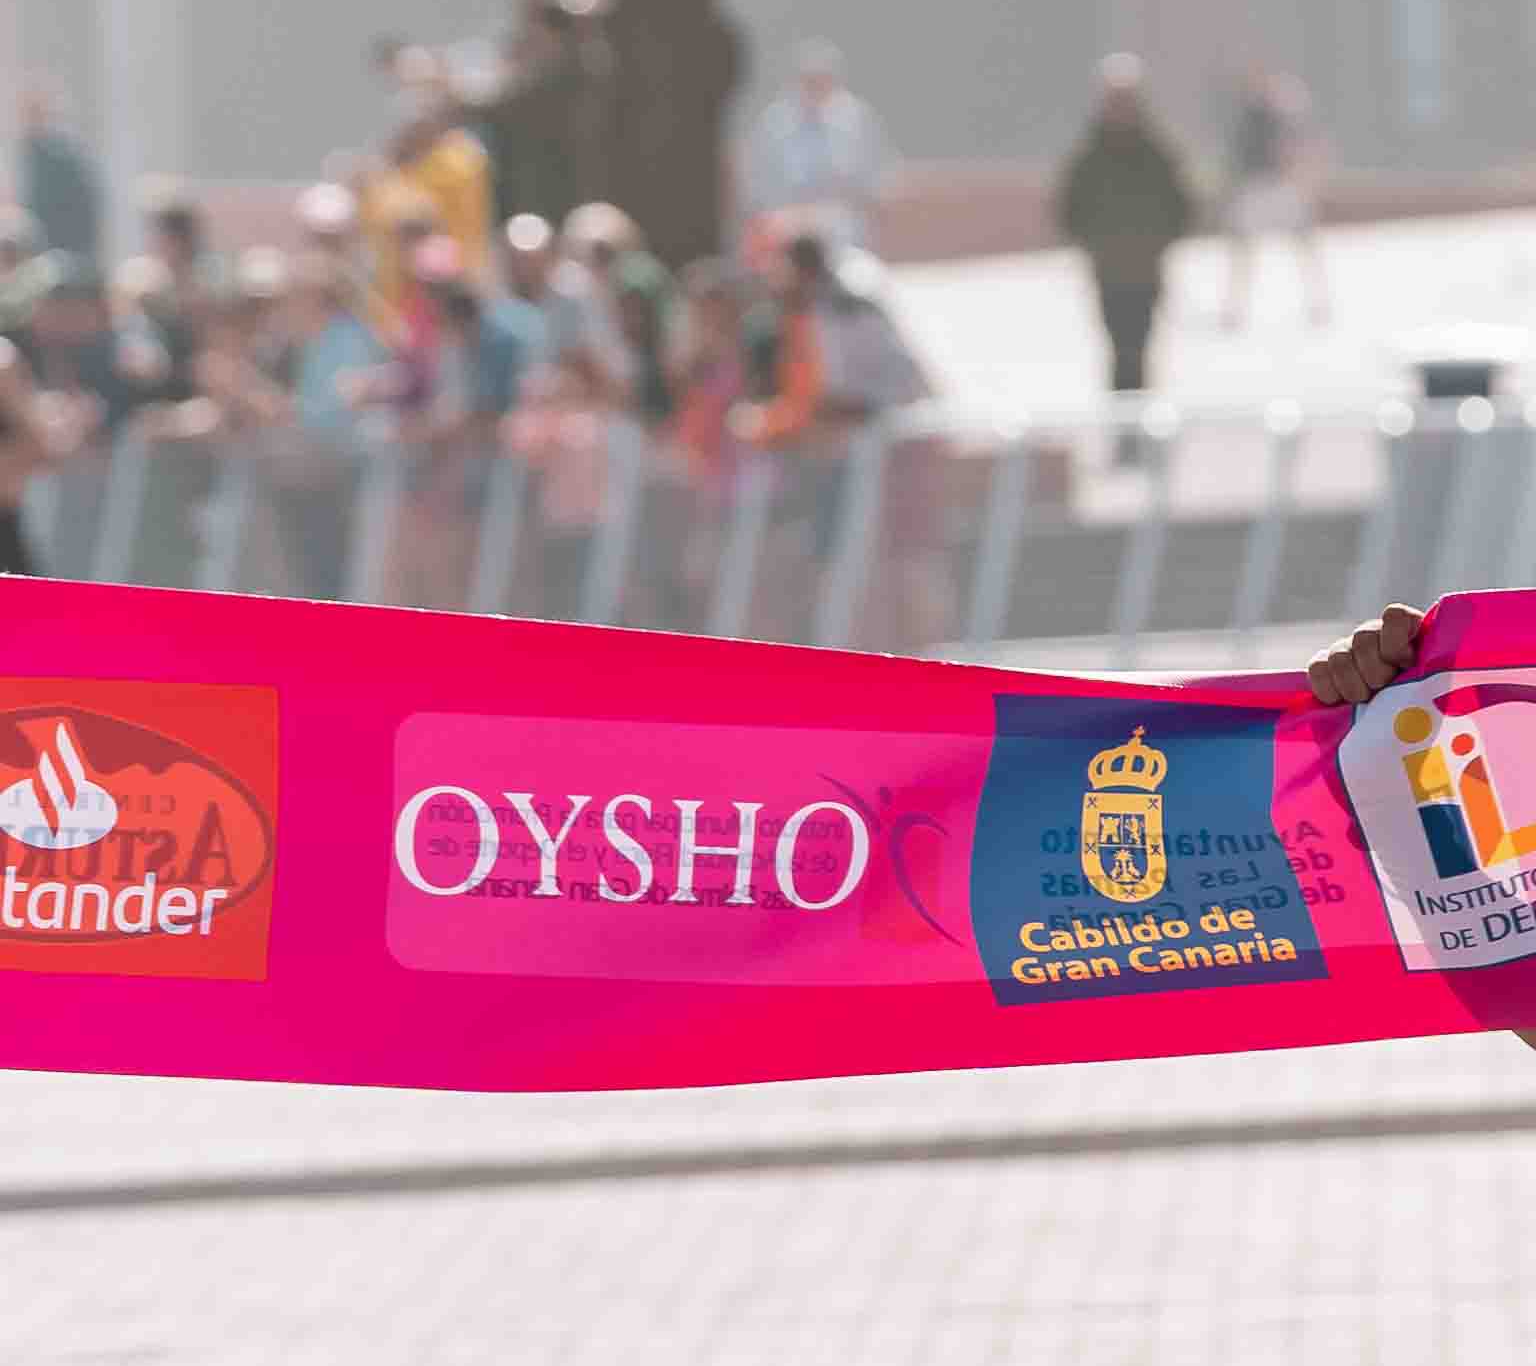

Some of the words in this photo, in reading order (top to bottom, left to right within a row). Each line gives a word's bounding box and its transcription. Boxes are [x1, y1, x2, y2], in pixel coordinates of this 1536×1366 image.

[395, 785, 870, 910] OYSHO
[1019, 916, 1191, 953] Cabildo
[1200, 906, 1257, 934] de
[1440, 925, 1478, 952] DE
[1011, 955, 1121, 985] Gran
[1128, 933, 1297, 973] Canaria
